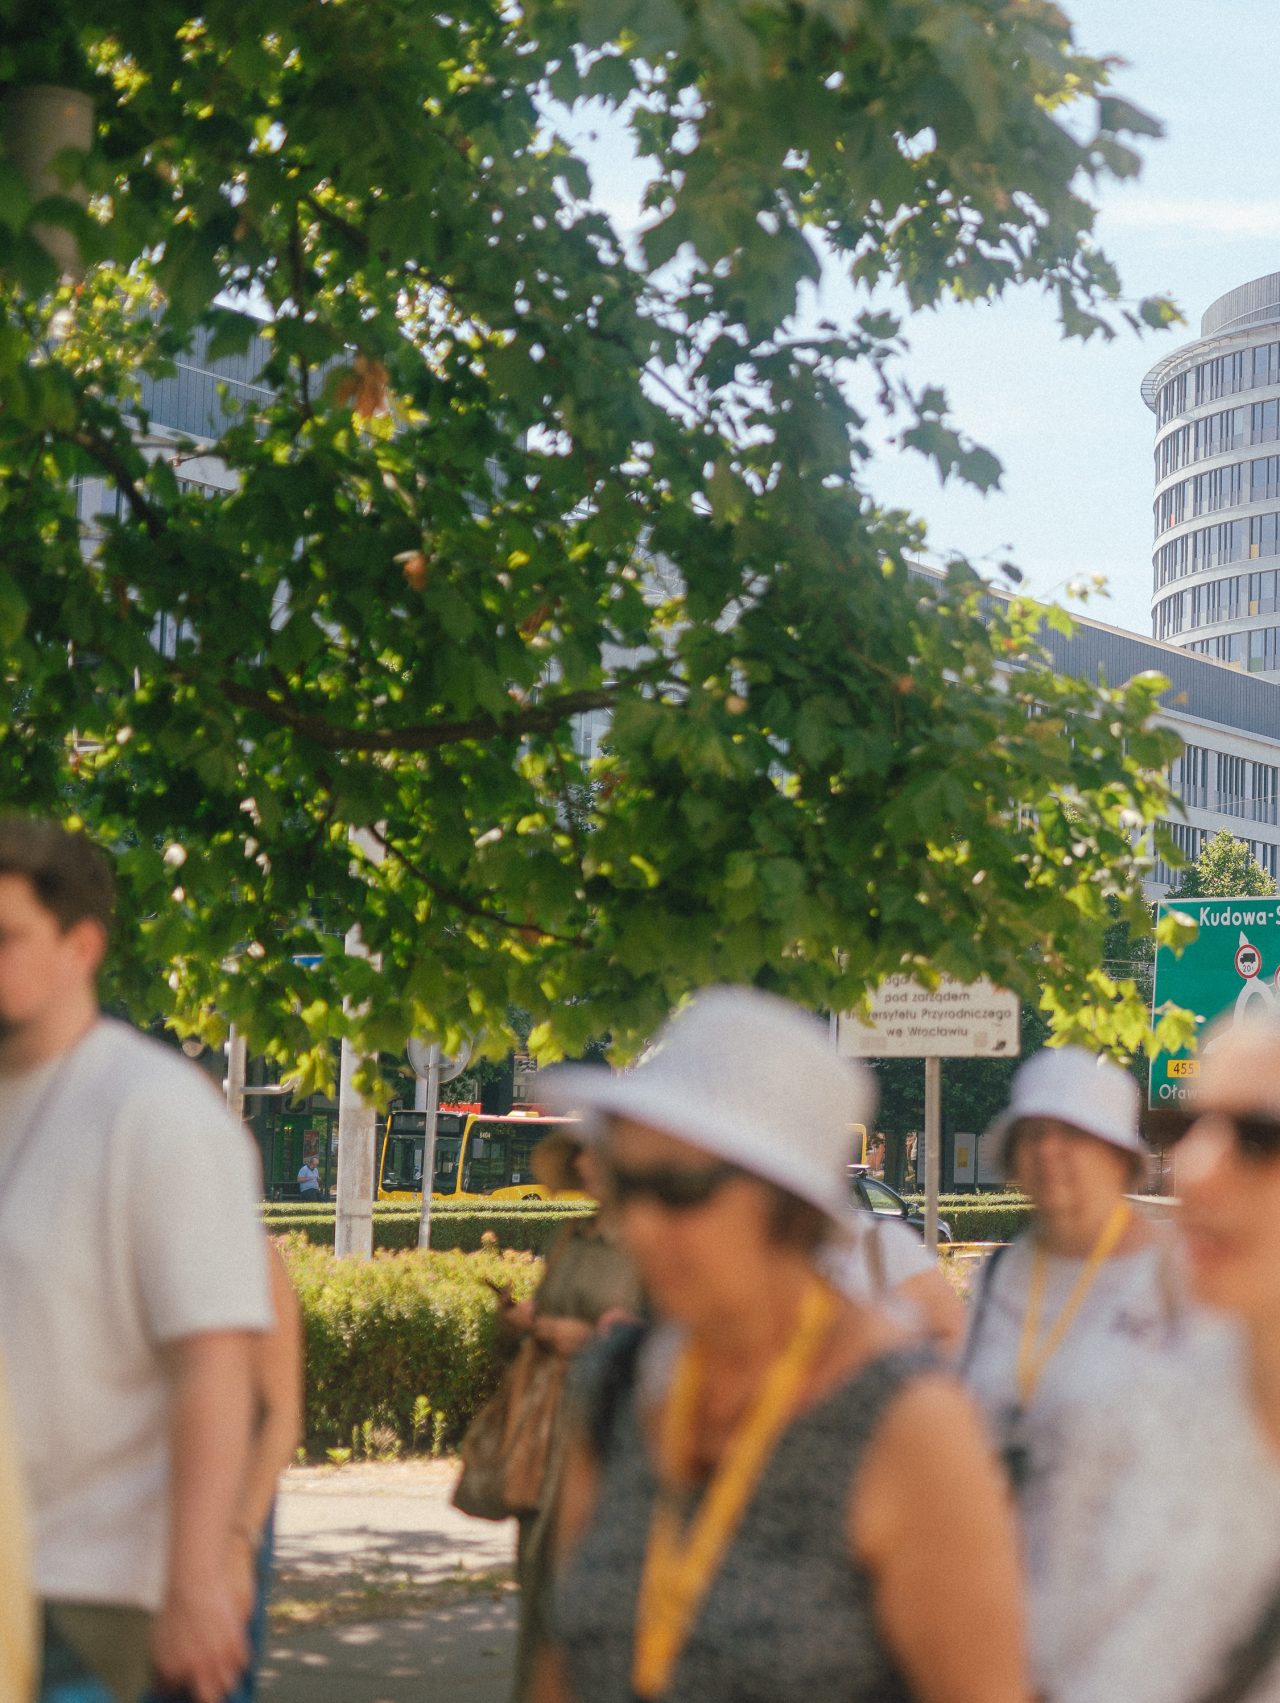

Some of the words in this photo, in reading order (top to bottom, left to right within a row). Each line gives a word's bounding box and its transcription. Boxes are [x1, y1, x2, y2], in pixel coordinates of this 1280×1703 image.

[884, 992, 907, 1004] pod
[921, 1008, 1012, 1021] Przyrodniczego
[886, 1028, 903, 1037] we
[1173, 1062, 1194, 1075] 455
[1158, 1083, 1199, 1100] Oław
